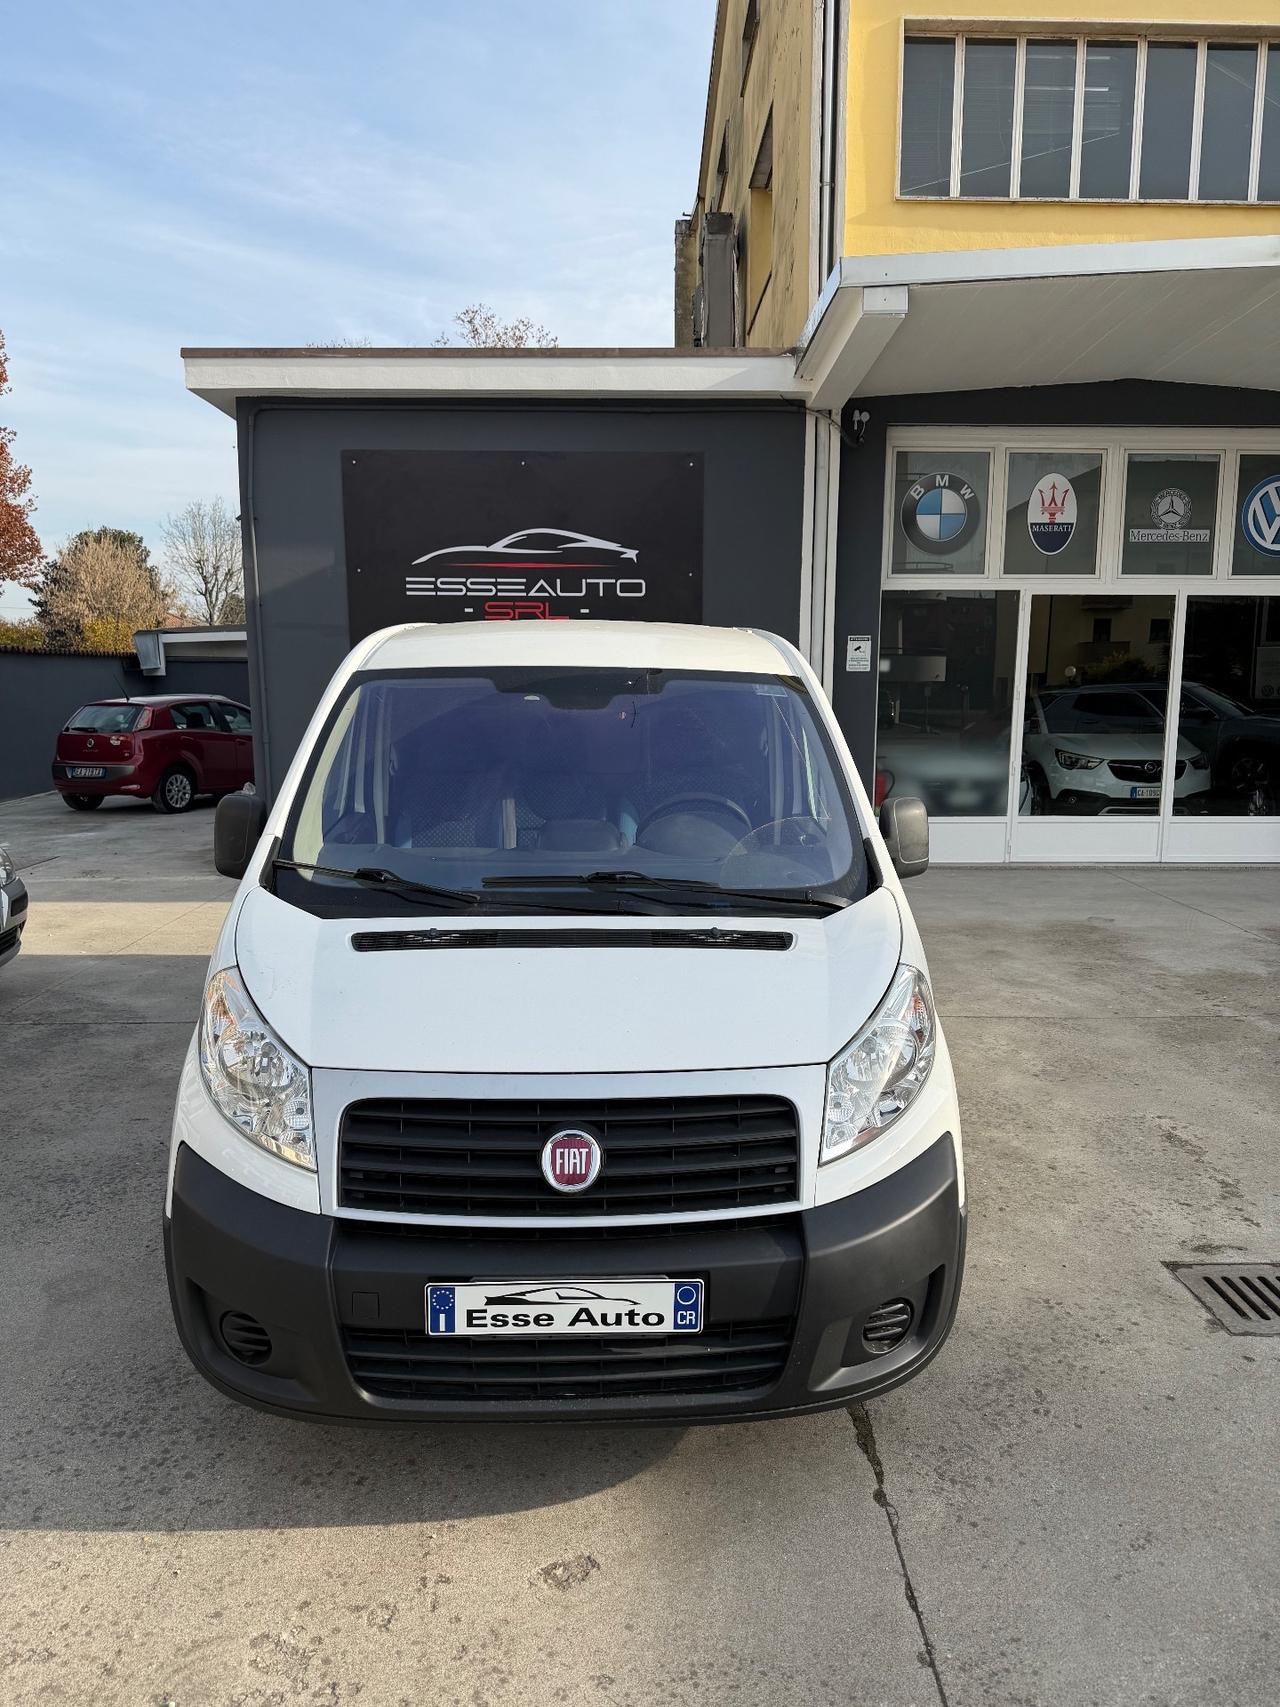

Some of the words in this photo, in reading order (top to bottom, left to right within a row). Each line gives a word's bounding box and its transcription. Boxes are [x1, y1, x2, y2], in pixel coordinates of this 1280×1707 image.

[910, 474, 975, 501] BMW
[1032, 524, 1071, 532] MASERATI
[1130, 530, 1208, 541] Mercedes-Benz
[405, 577, 646, 597] ESSEAUTO
[484, 602, 570, 620] SRL
[555, 1148, 589, 1175] FIAT
[466, 1308, 555, 1328] Esse
[567, 1307, 666, 1327] Auto
[677, 1311, 696, 1325] CR
